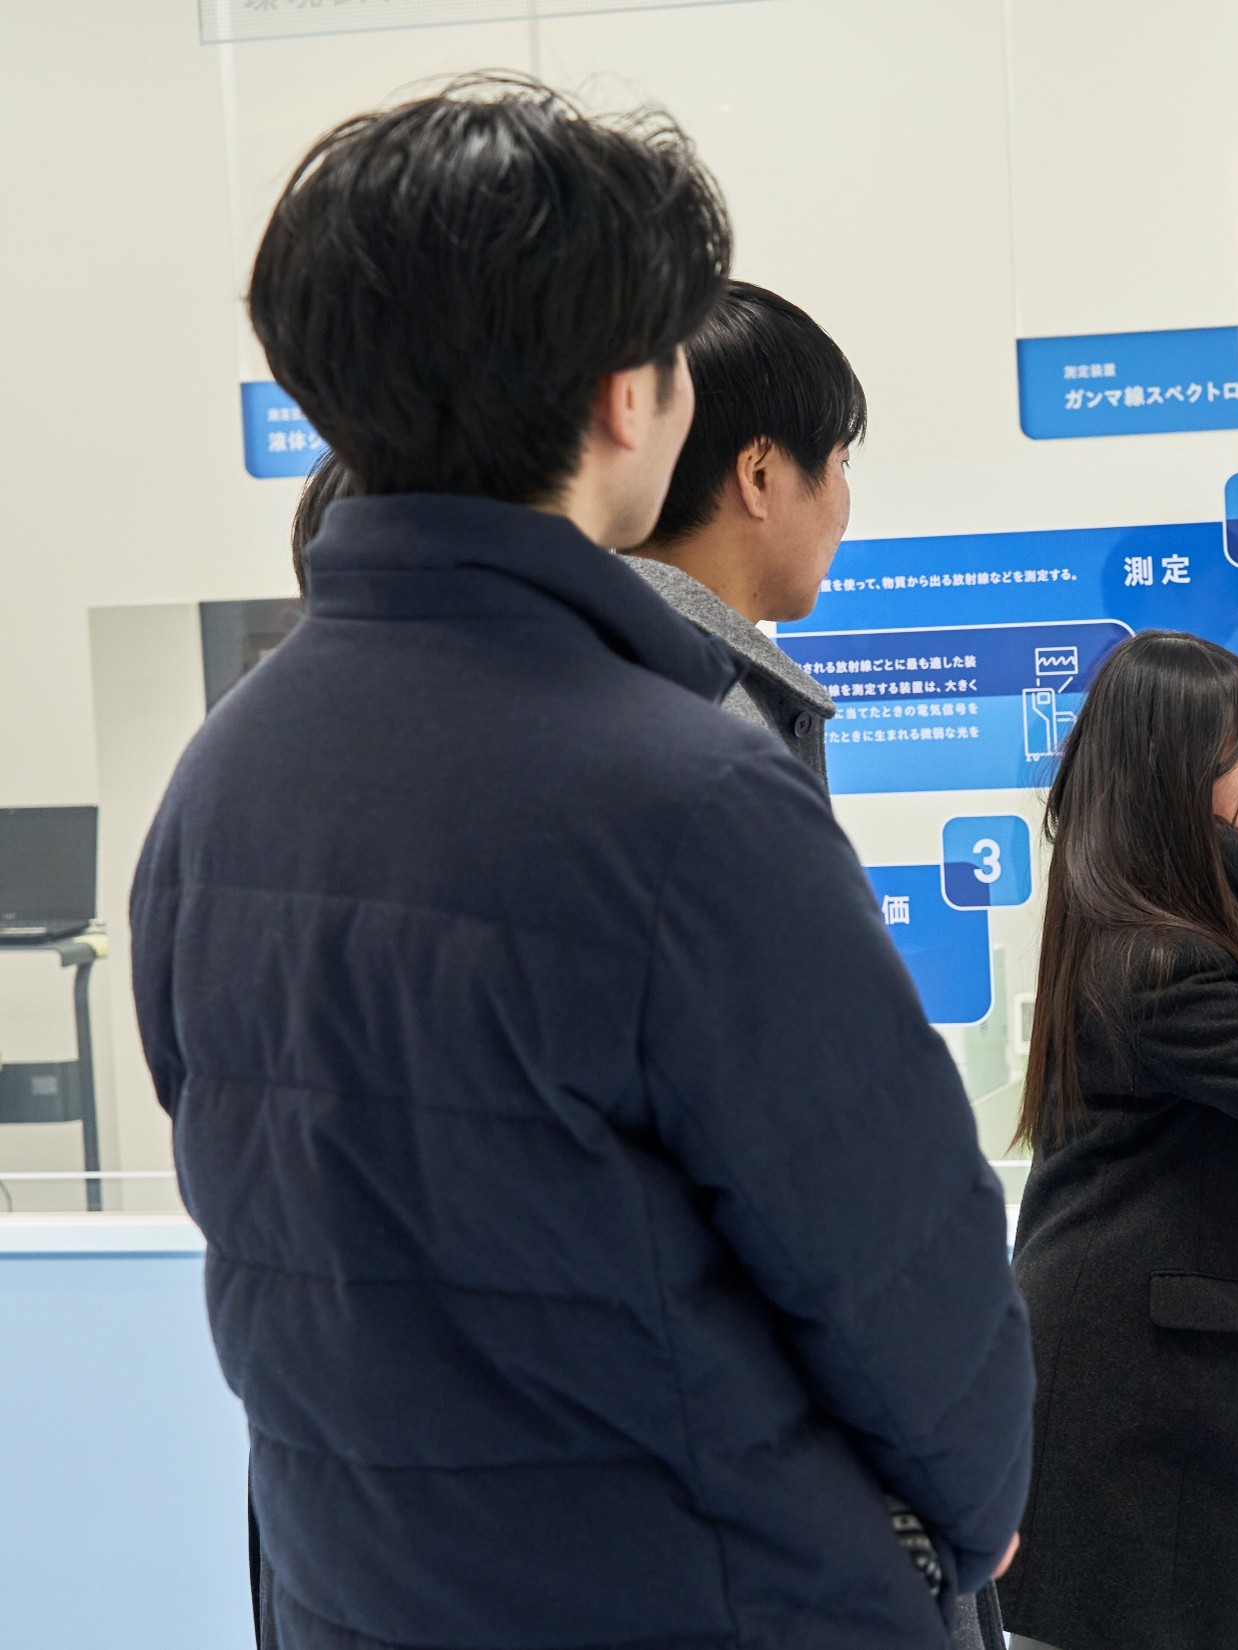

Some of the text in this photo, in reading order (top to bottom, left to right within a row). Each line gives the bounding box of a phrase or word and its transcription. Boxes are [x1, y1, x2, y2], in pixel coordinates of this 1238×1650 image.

[818, 568, 1078, 593] 置を使って、物質から出る放射線などを測定する。
[1123, 553, 1191, 587] 測定
[799, 655, 977, 675] される放射線ごとに最も適した装
[823, 679, 978, 698] 線を測定する装置は、大きく
[972, 838, 1001, 883] 3
[882, 895, 910, 925] 価
